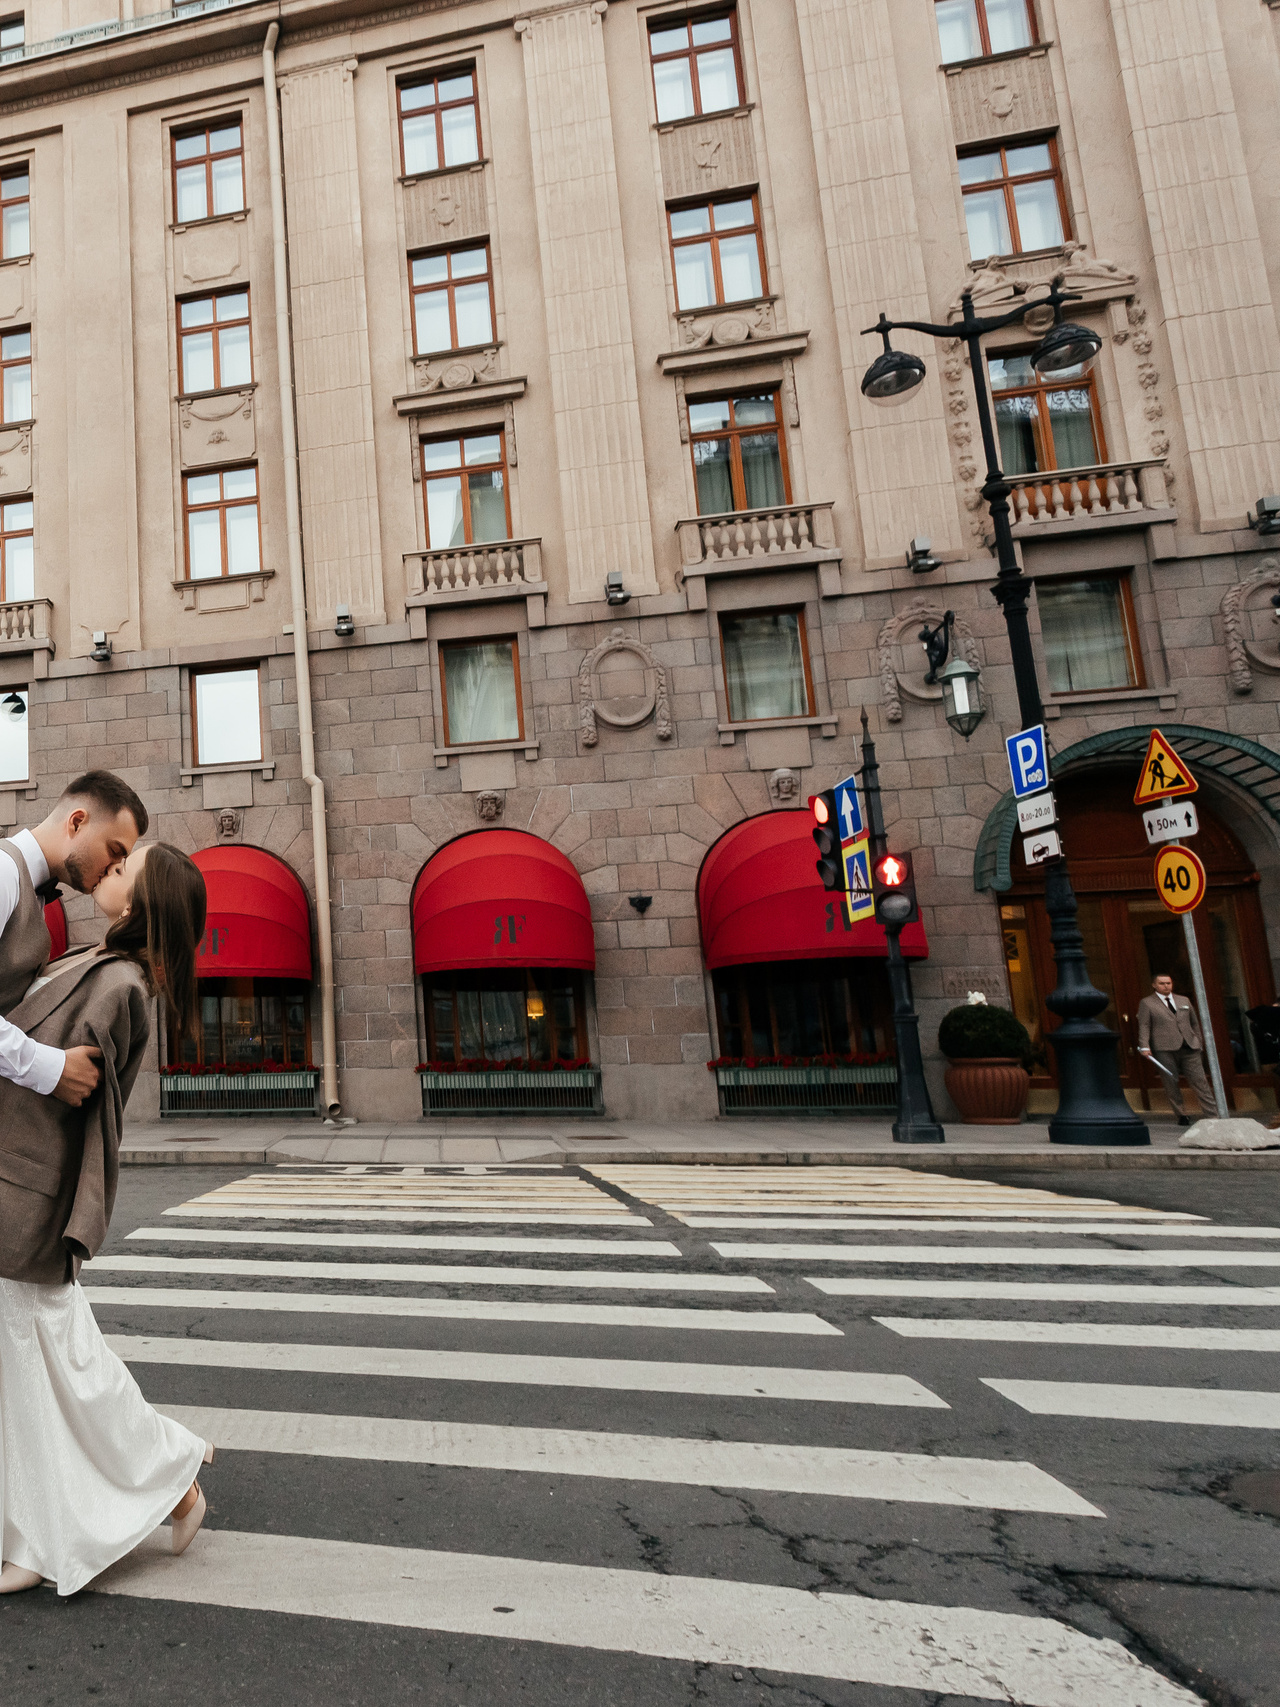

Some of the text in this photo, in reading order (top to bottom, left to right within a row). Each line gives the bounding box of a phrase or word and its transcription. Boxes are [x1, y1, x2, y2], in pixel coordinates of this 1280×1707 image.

[1016, 737, 1037, 788] P
[1020, 806, 1051, 823] 8.00-20.00
[1163, 865, 1191, 893] 40
[948, 978, 1001, 989] ASTORIA
